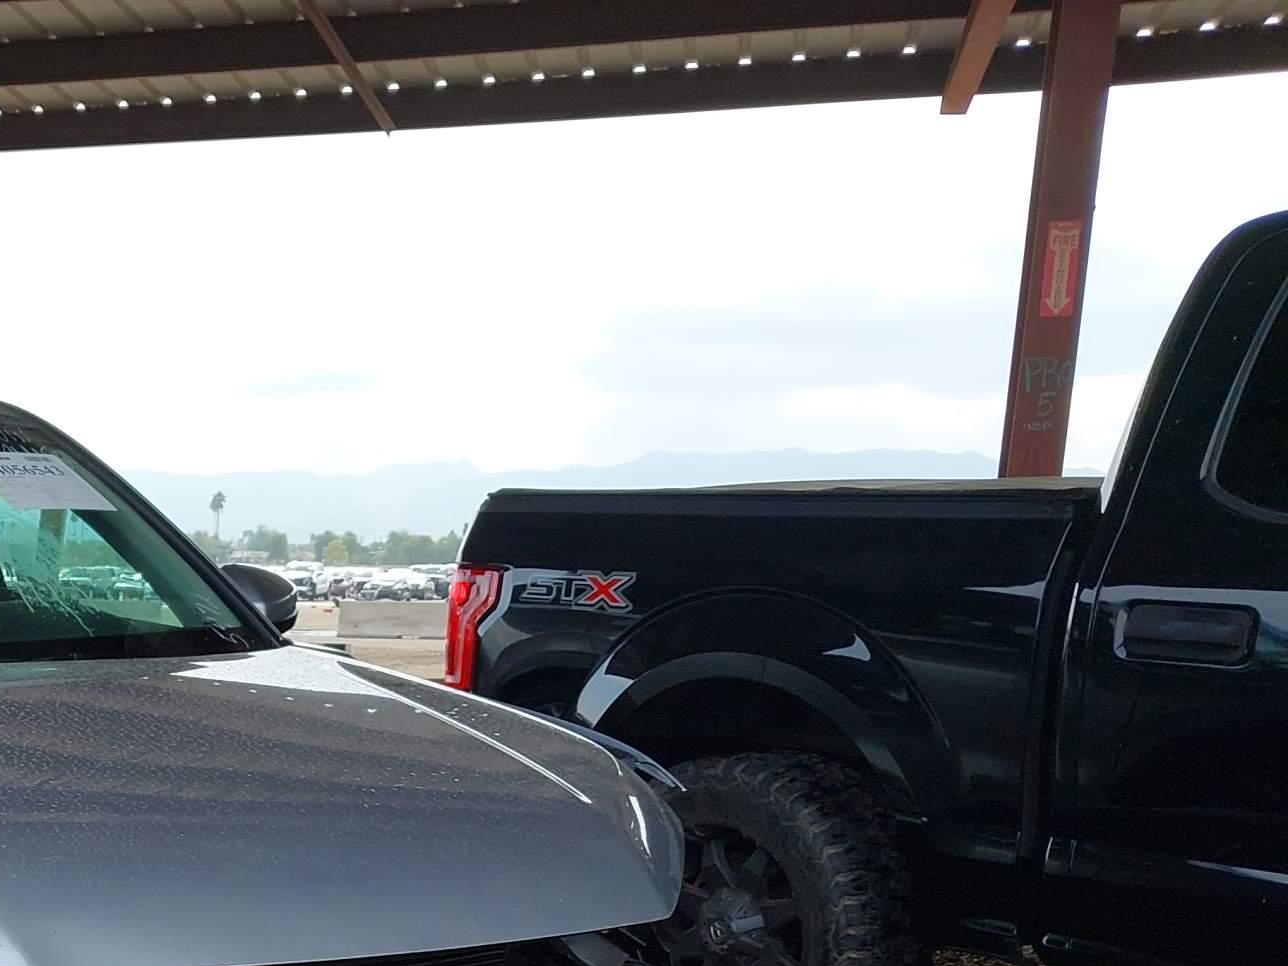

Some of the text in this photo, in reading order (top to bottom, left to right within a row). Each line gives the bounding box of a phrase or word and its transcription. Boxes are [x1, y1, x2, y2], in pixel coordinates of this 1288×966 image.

[1052, 233, 1078, 248] FIRE
[1037, 391, 1056, 416] 5
[519, 570, 637, 612] STX
